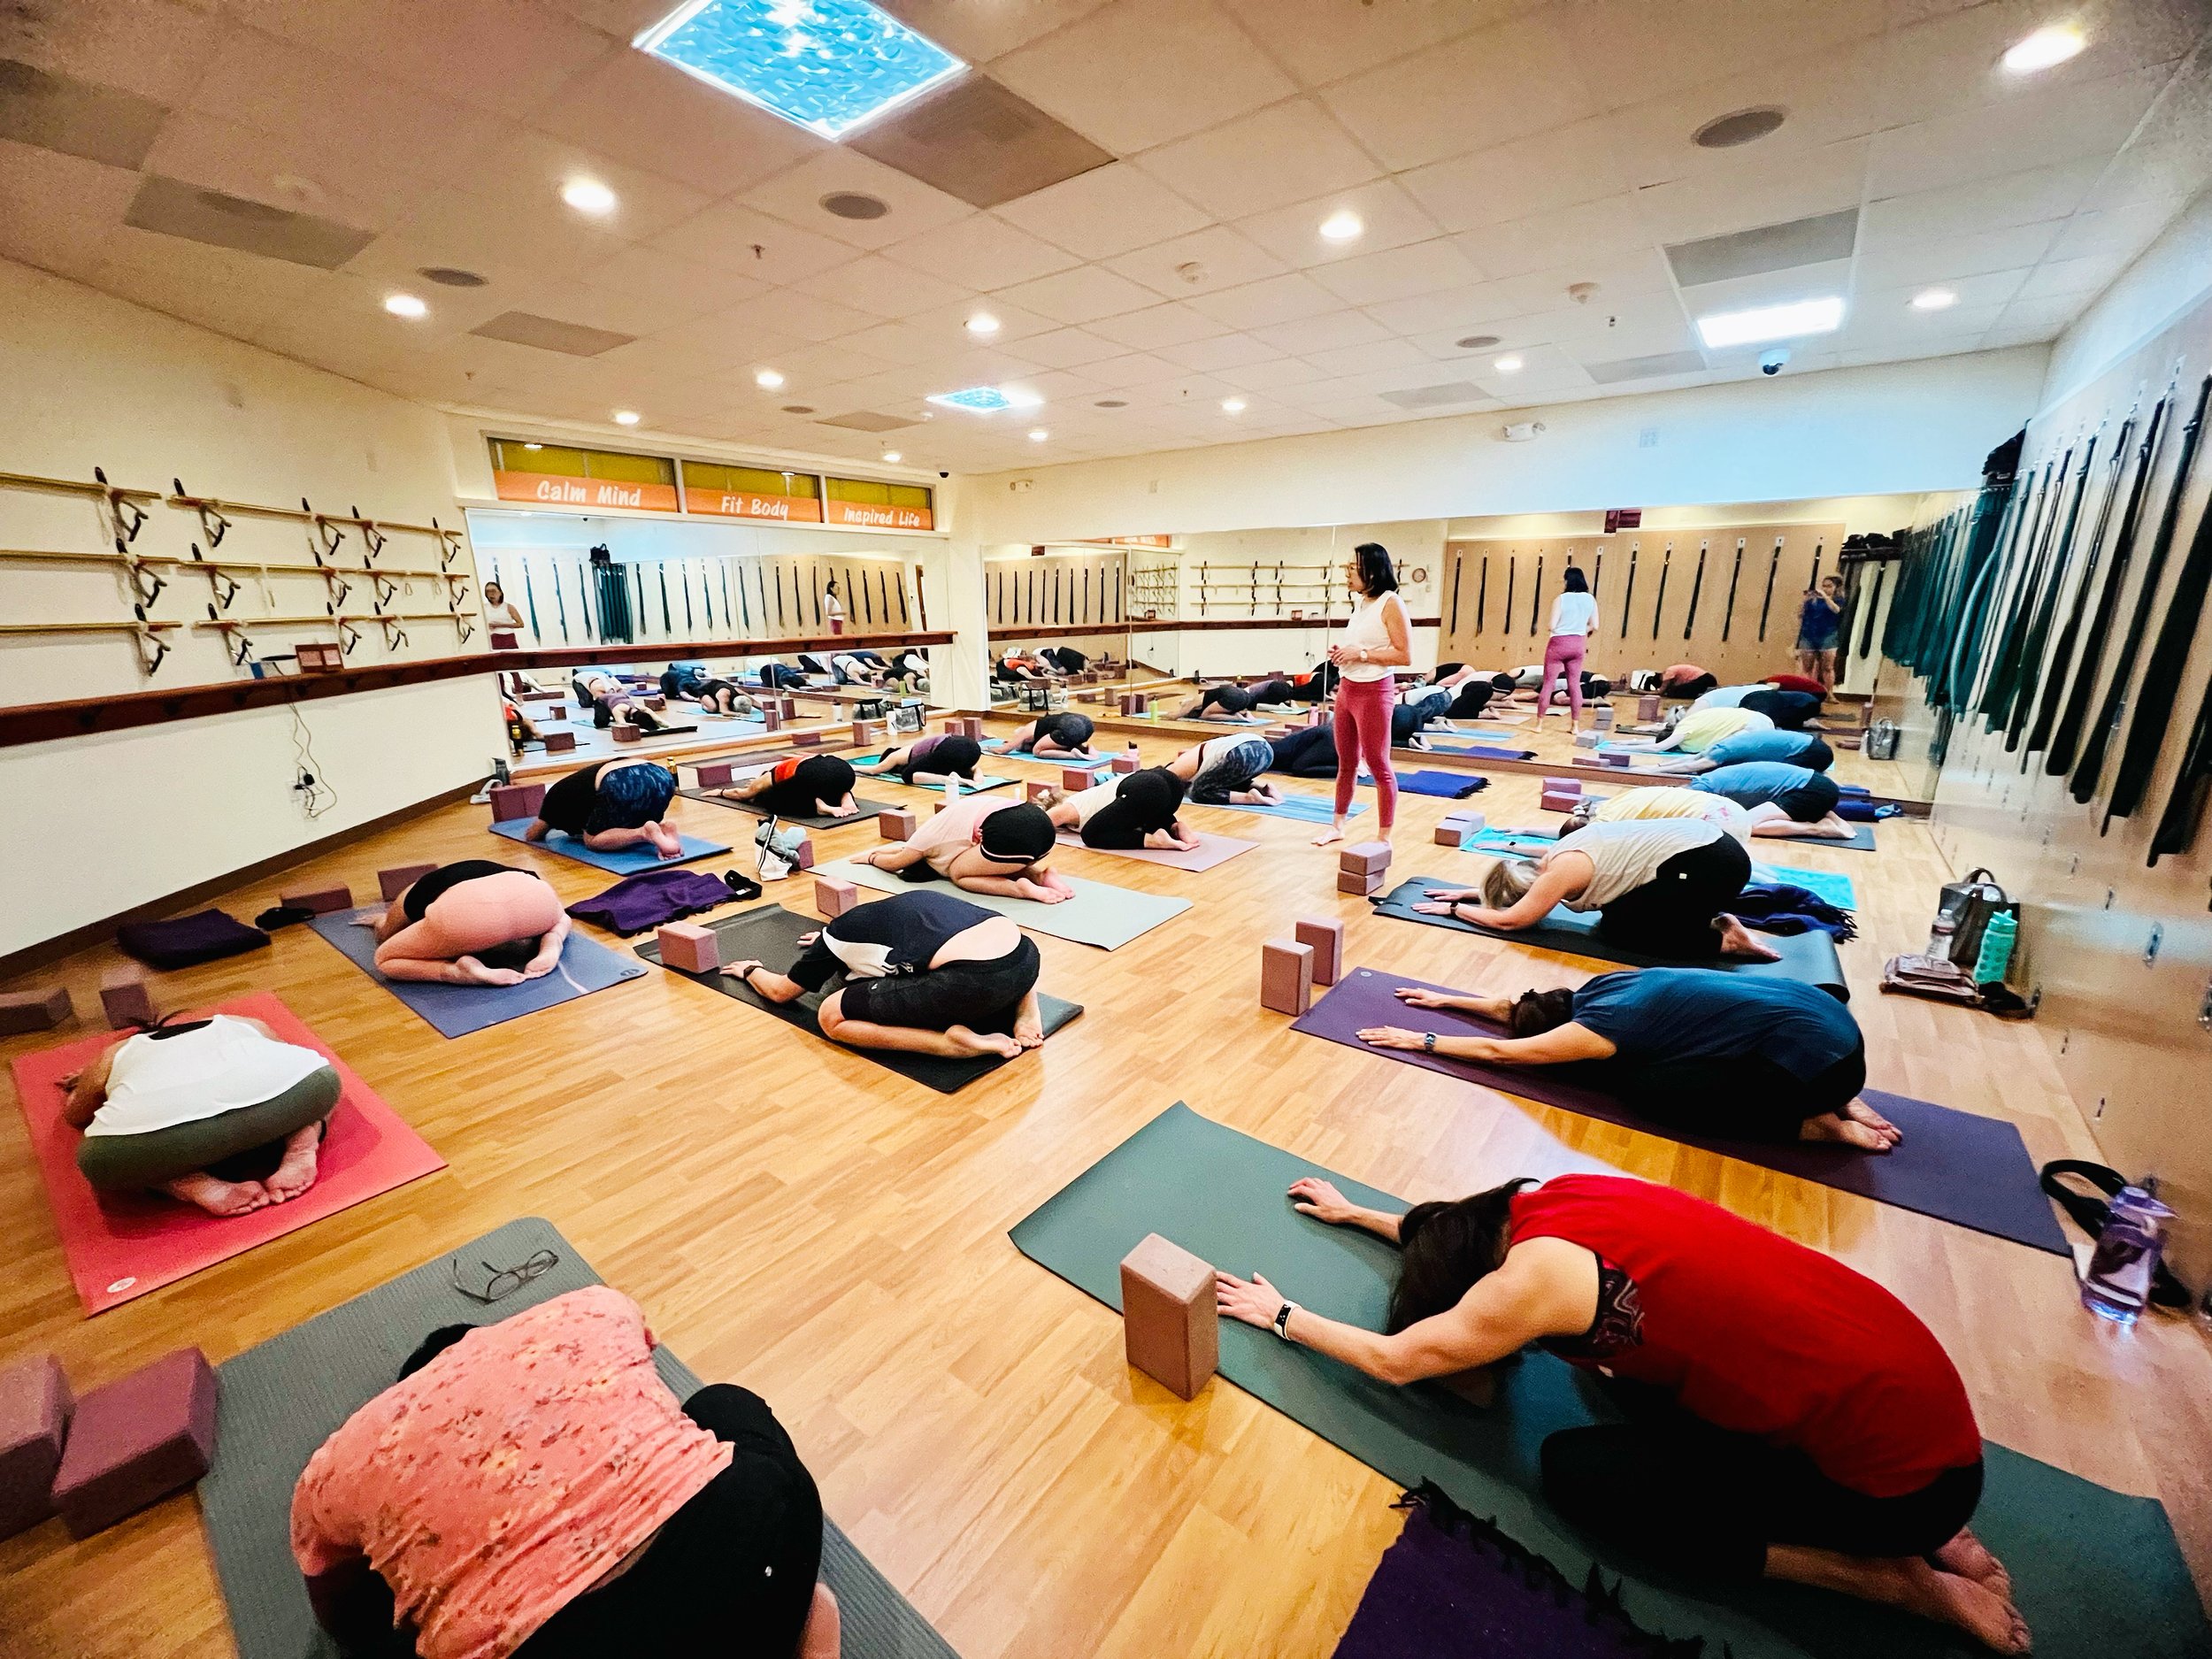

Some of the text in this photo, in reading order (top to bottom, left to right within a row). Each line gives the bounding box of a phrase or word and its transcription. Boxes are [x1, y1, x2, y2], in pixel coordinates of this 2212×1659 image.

[536, 480, 641, 507] Calm Mind
[721, 495, 789, 520] Fit Body
[843, 507, 920, 527] Inspired Life
